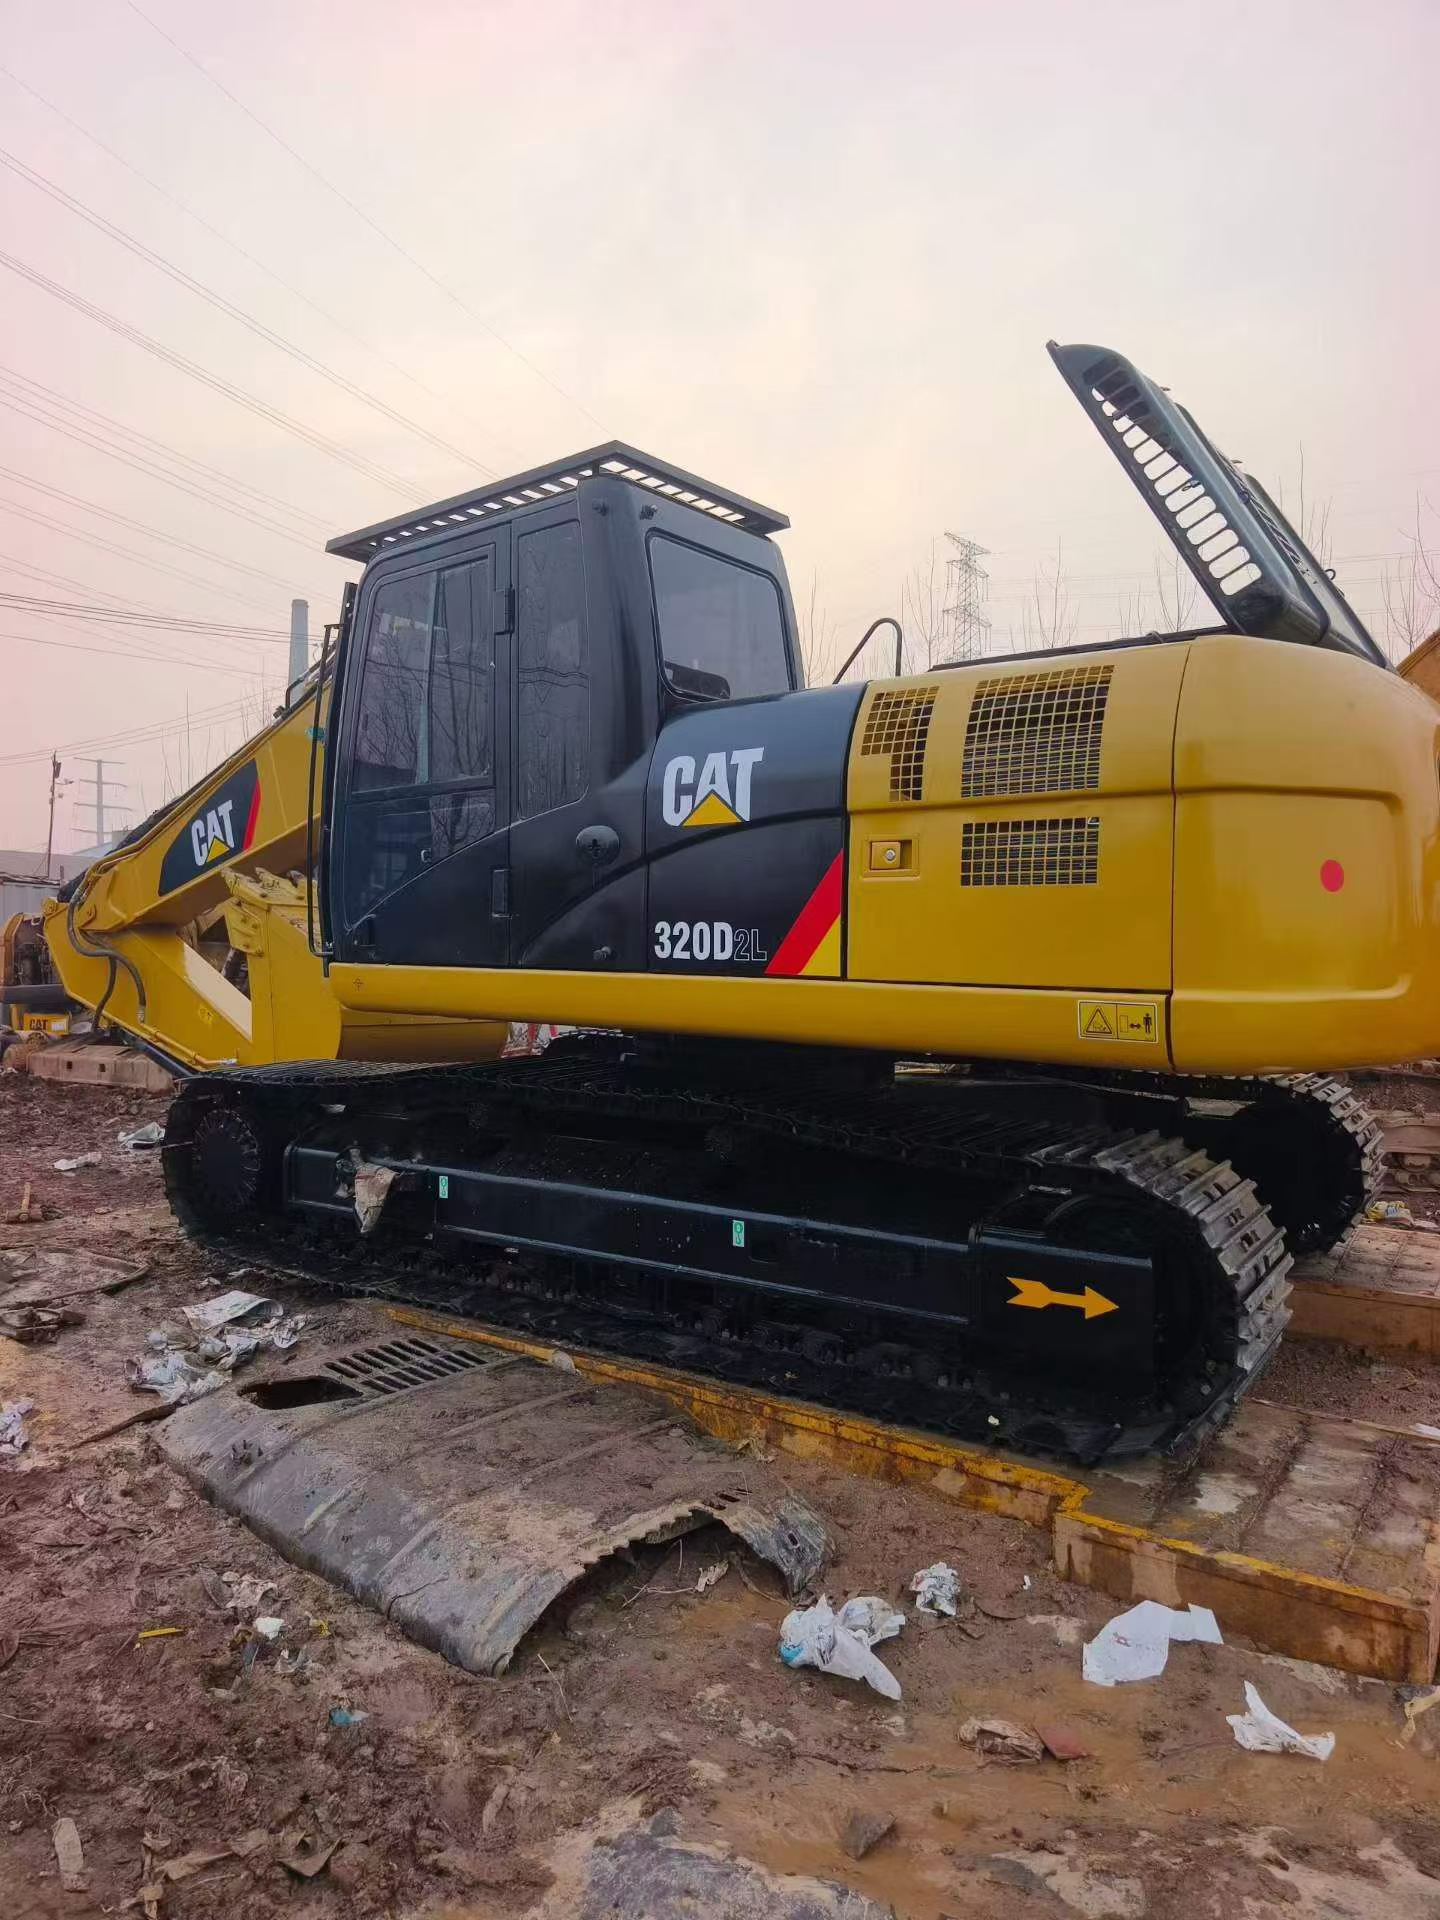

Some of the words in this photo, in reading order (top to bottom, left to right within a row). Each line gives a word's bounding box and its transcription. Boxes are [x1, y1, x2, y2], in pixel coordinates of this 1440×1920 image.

[662, 746, 765, 827] CAT
[191, 799, 235, 867] CAT
[30, 1019, 48, 1031] CAT
